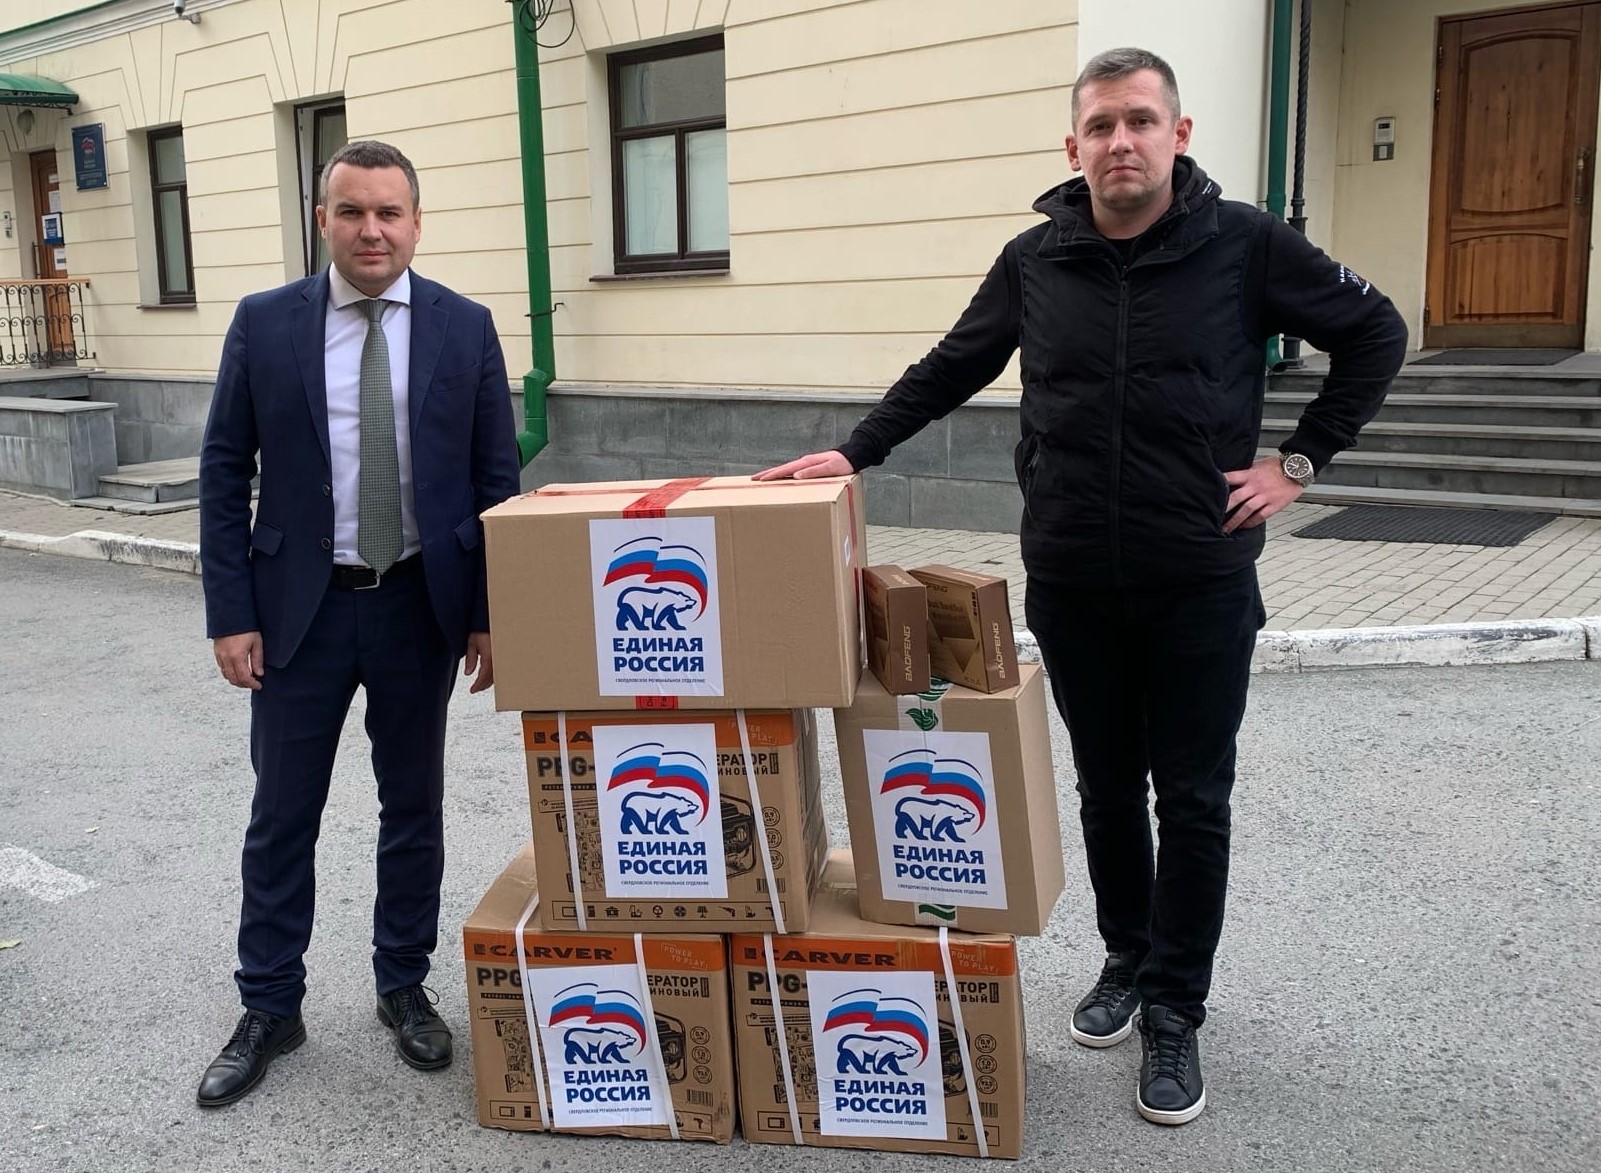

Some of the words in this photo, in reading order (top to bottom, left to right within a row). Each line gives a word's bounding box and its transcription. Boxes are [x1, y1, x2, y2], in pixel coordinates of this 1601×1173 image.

[612, 637, 704, 654] ЕДИНАЯ
[903, 625, 913, 682] BAOFENG
[992, 622, 1006, 679] BAOFENG
[613, 656, 705, 672] РОССИЯ
[617, 841, 707, 858] ЕДИНАЯ
[893, 844, 984, 865] ЕДИНАЯ
[619, 859, 708, 875] РОССИЯ
[895, 862, 987, 885] РОССИЯ
[489, 944, 614, 961] CARVER
[934, 980, 988, 994] ЕРТОР
[935, 993, 989, 1004] ИНВЫЙ
[563, 1068, 649, 1086] ЕДИНАЯ
[566, 1085, 651, 1103] РОССИЯ
[834, 1079, 926, 1096] ЕДИНАЯ
[835, 1096, 927, 1115] РОССИЯ
